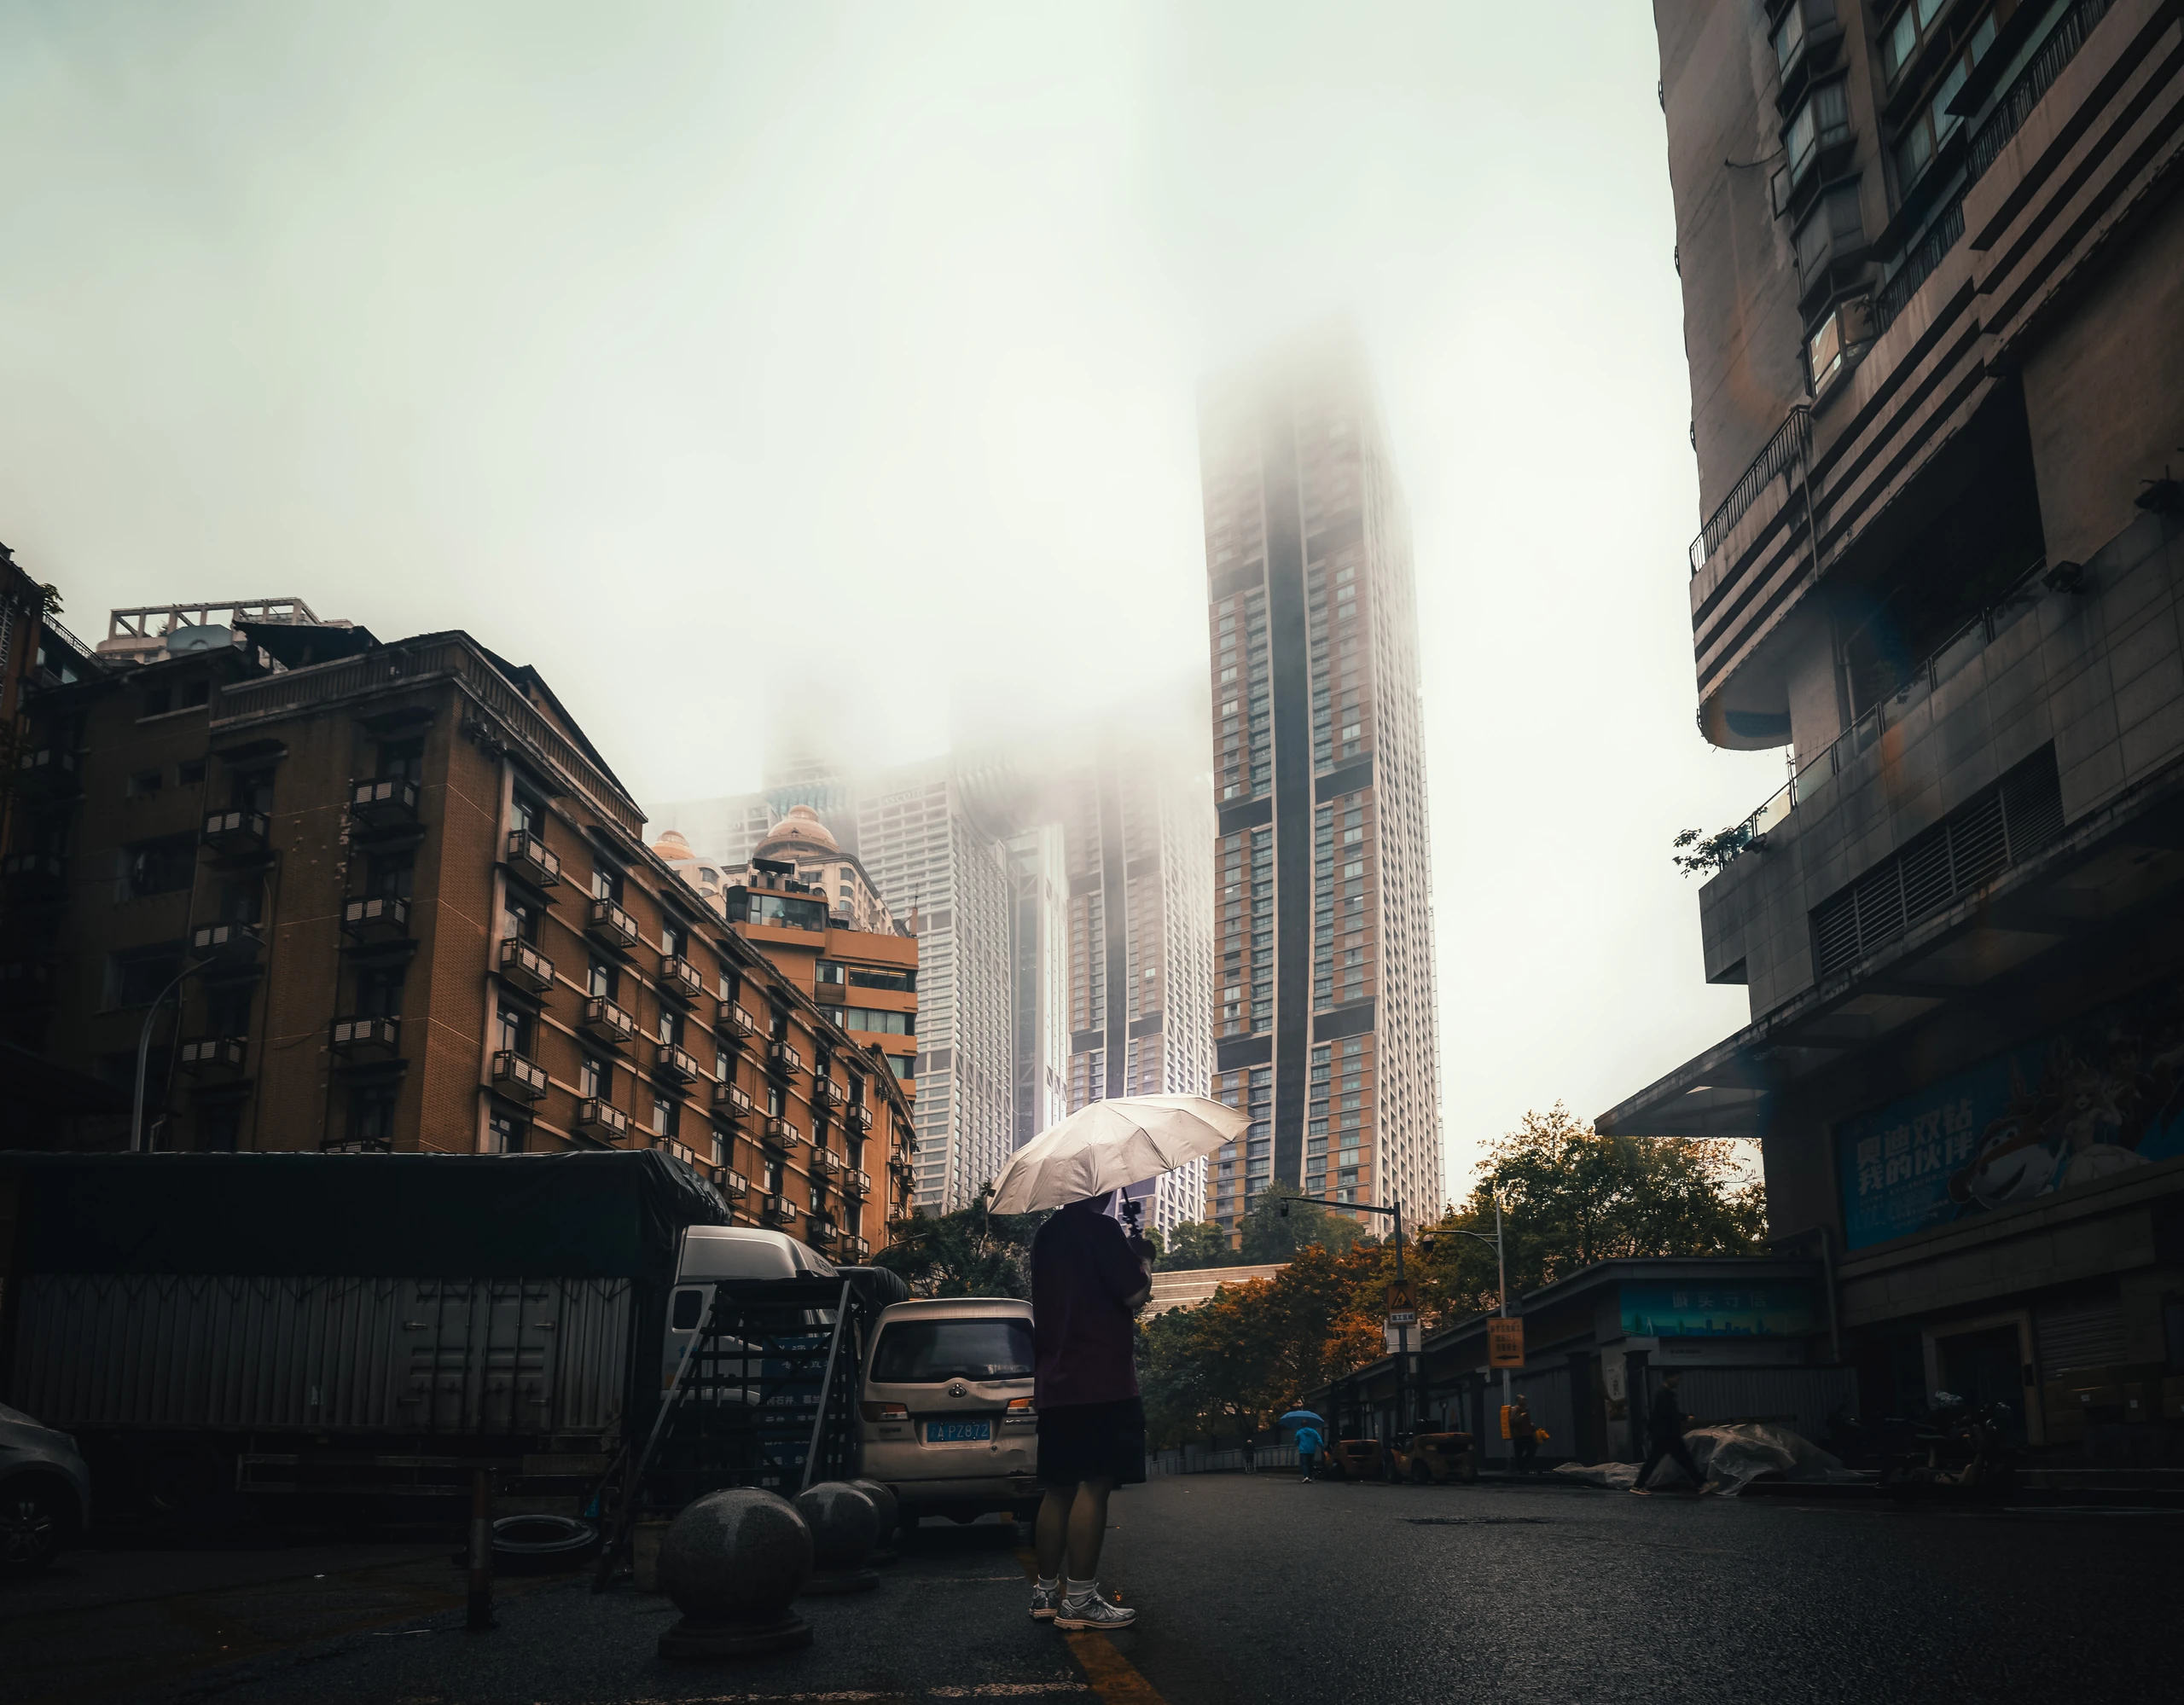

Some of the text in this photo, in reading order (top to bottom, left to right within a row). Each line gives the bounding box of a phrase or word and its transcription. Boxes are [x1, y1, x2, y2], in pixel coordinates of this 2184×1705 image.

[883, 788, 922, 804] ASCOTT
[1856, 1097, 1973, 1170] 奥迪双钻
[1857, 1130, 1973, 1196] 我的伙伴
[1672, 1290, 1768, 1308] 诚实守信
